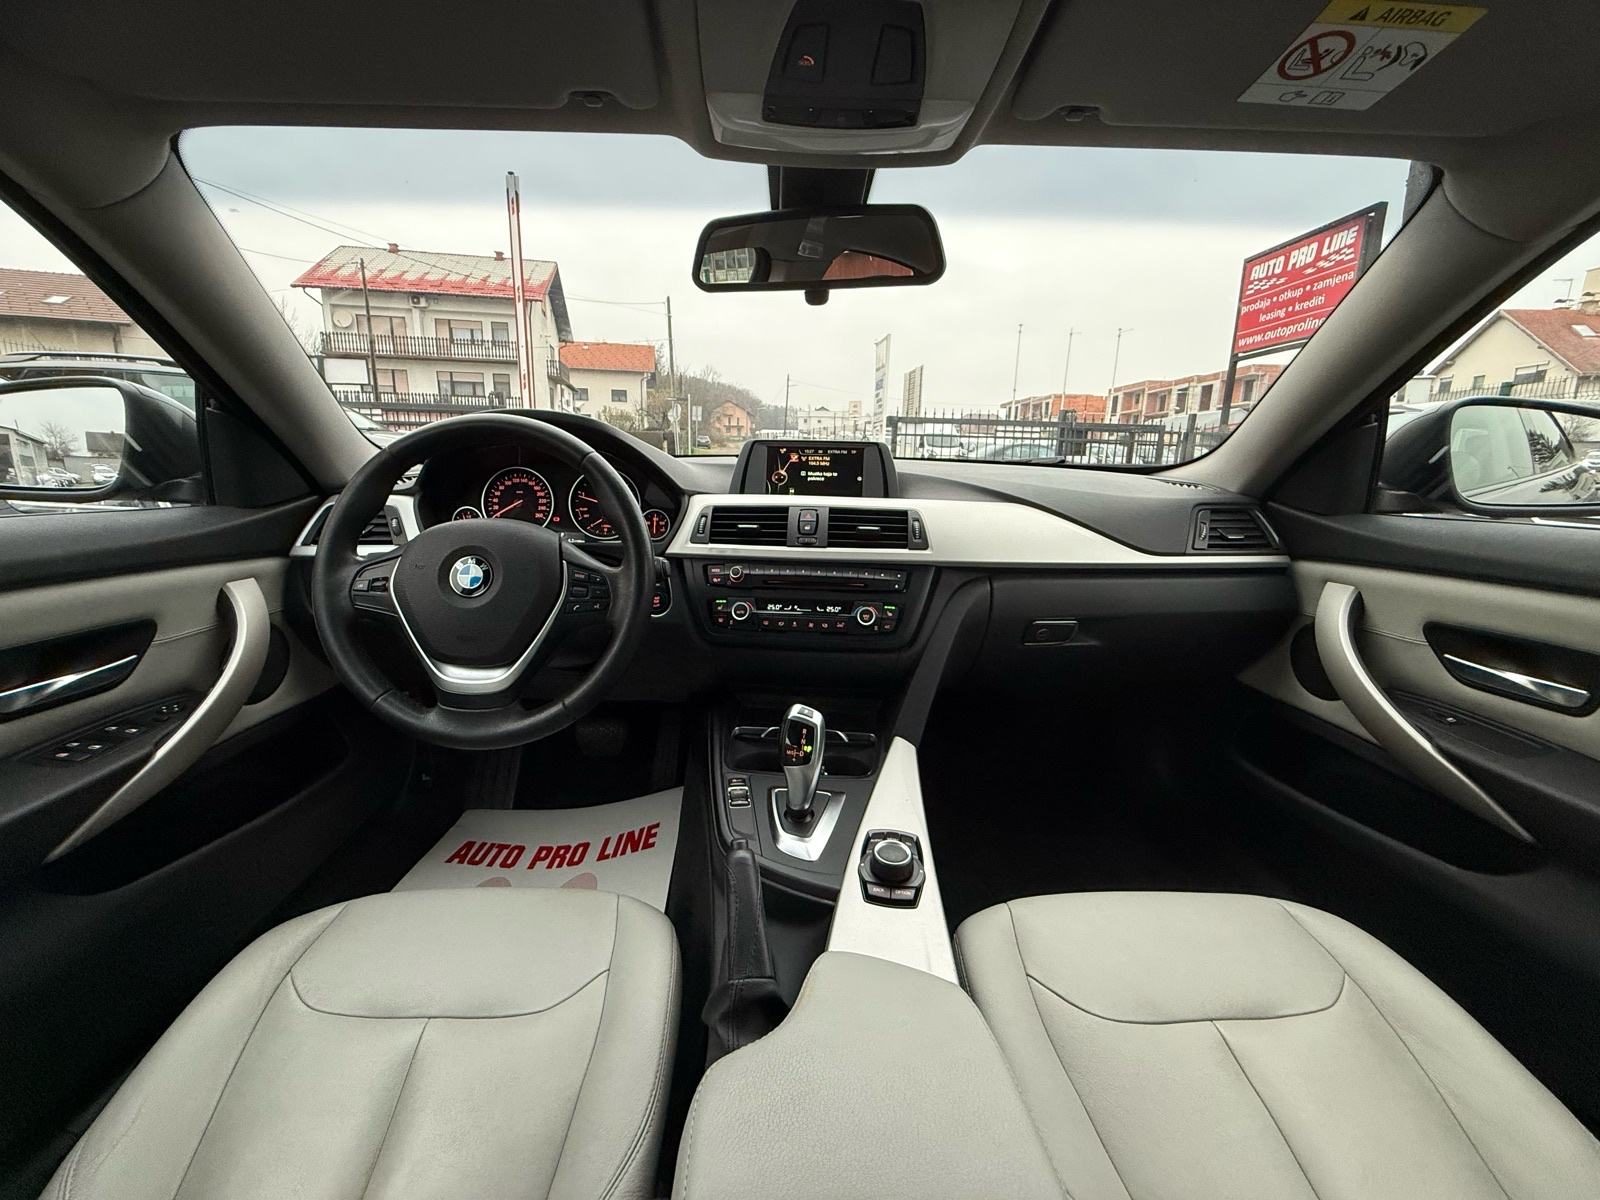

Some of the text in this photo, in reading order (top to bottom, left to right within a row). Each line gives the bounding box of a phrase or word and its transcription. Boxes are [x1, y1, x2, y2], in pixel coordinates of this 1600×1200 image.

[1375, 8, 1453, 28] AIRBAG
[1250, 225, 1360, 281] AUTO PRO LINE
[1240, 271, 1354, 316] prodaja otkup zamjena
[1259, 294, 1326, 323] leasing krediti
[444, 822, 661, 870] AUTO PRO LINE
